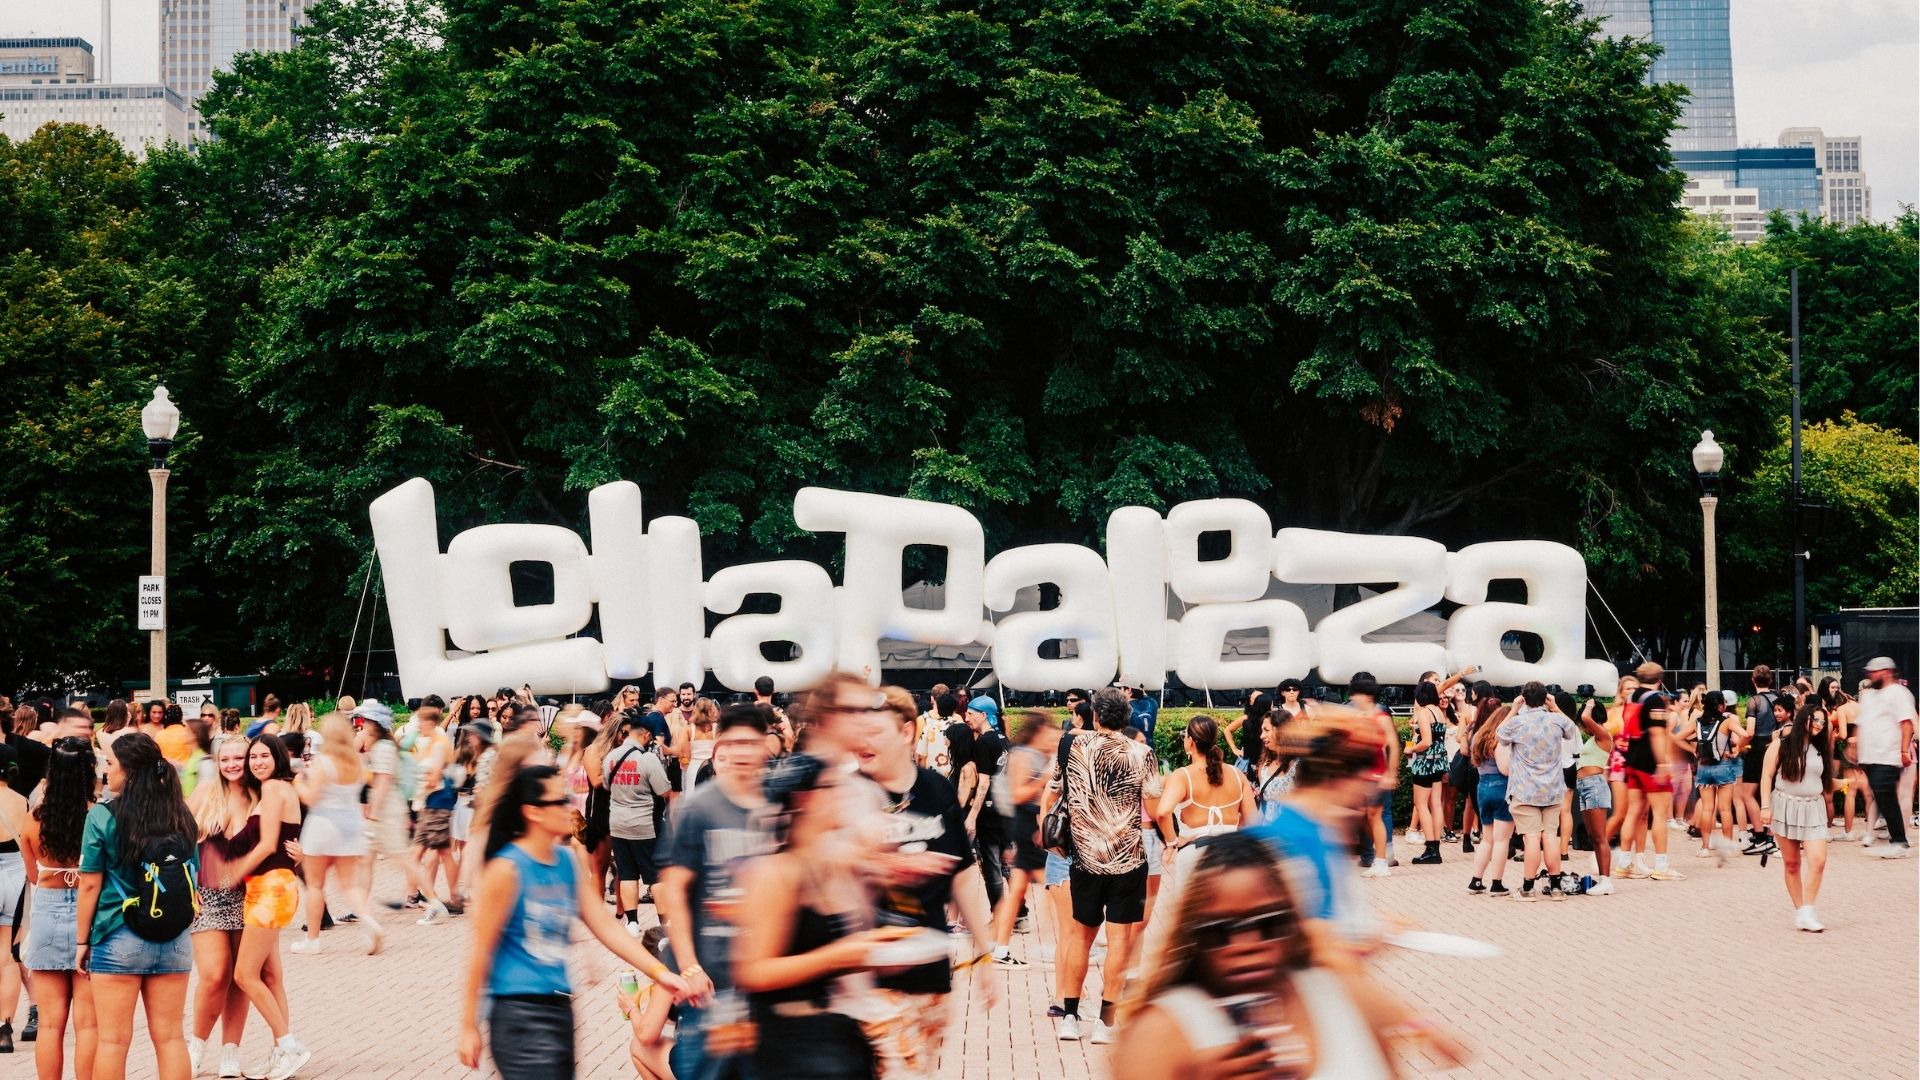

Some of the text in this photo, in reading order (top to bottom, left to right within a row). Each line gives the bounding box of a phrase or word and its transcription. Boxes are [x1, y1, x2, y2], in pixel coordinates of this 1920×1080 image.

[141, 596, 162, 605] CLOSES
[143, 610, 159, 618] 11 PM
[180, 695, 200, 704] TRASH
